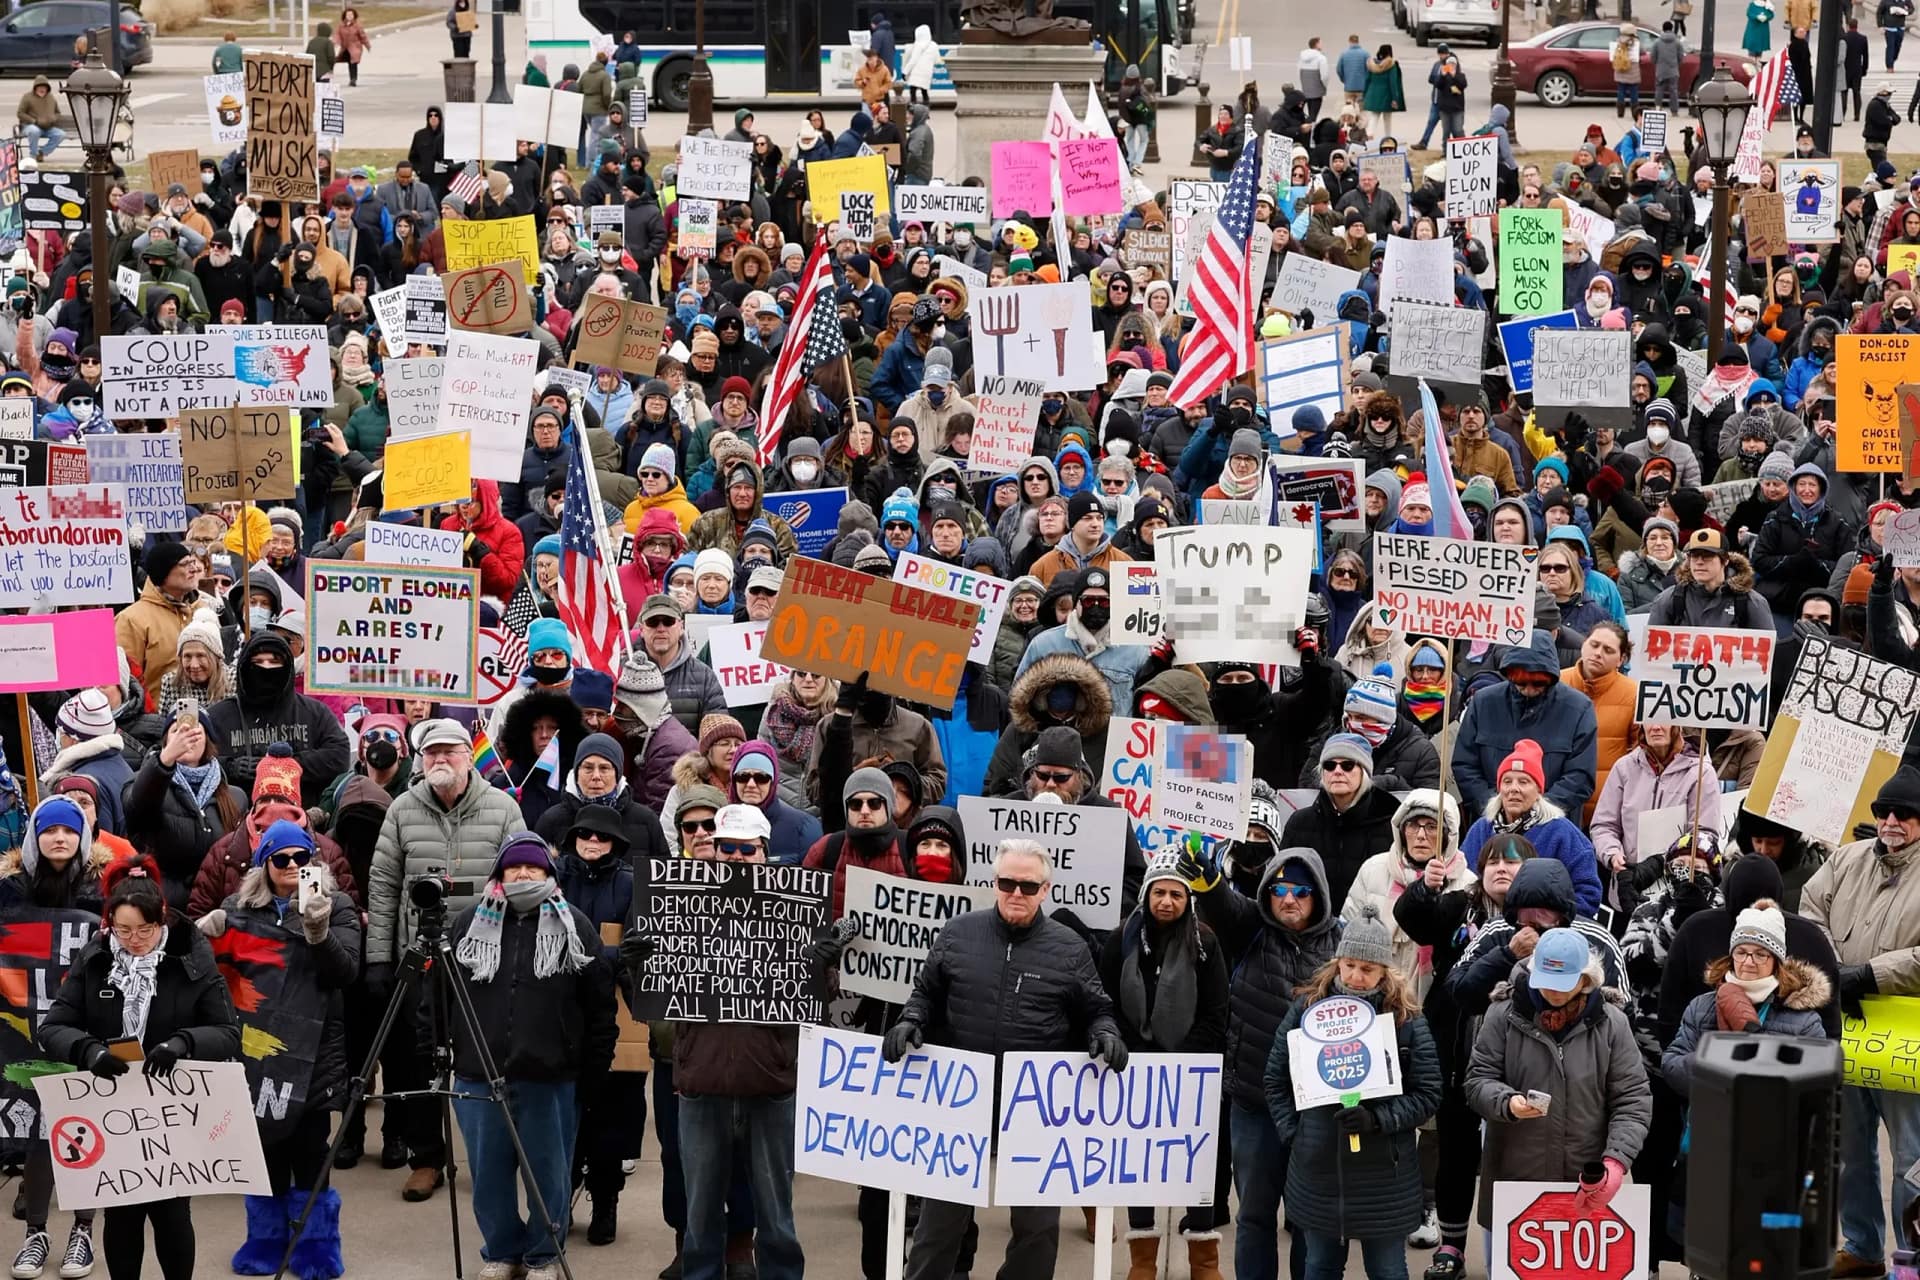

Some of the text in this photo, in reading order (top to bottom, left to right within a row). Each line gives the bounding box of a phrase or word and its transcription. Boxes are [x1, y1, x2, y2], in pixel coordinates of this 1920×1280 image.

[246, 60, 313, 98] DEPORT
[251, 97, 309, 136] ELON
[250, 137, 316, 179] MUSK
[703, 141, 720, 156] THE
[1063, 144, 1085, 158] IF
[1452, 140, 1492, 157] LOCK
[696, 163, 739, 177] REJECT
[1463, 160, 1480, 176] UP
[683, 176, 749, 192] PROJECT 2025
[1450, 177, 1490, 194] ELON
[841, 194, 874, 210] LOCK
[901, 193, 917, 210] DO
[920, 194, 985, 214] SOMETHING
[1448, 199, 1498, 216] FE-LON
[847, 210, 874, 225] HIM
[1513, 215, 1545, 231] FORK
[450, 220, 527, 240] STOP THE
[854, 223, 872, 238] UP!
[1507, 230, 1556, 246] FASCISM
[457, 240, 529, 257] ILLEGAL
[1295, 258, 1327, 279] It's
[1512, 257, 1550, 273] ELON
[122, 271, 132, 284] NO
[1284, 273, 1317, 293] giving
[1514, 275, 1548, 290] MUSK
[1514, 290, 1543, 311] GO
[590, 306, 654, 333] COUP NO
[233, 329, 254, 341] ONE
[258, 328, 272, 341] IS
[275, 327, 326, 341] ILLEGAL
[1407, 327, 1473, 350] REJECT
[1860, 339, 1910, 349] DON-OLD
[127, 339, 209, 364] COUP
[457, 344, 481, 361] Elon
[623, 344, 657, 361] 2025
[1538, 336, 1628, 364] BIG GRETCH
[1859, 352, 1907, 362] FASCIST
[109, 362, 225, 376] IN PROGRESS
[1400, 350, 1451, 372] PROJECT
[1538, 362, 1624, 379] WE NEED YOUR
[126, 379, 205, 393] THIS IS
[250, 388, 328, 402] STOLEN LAND
[390, 384, 439, 399] doesn't
[981, 375, 1006, 396] NO
[114, 397, 170, 413] NOT A
[448, 403, 521, 426] TERRORIST
[979, 398, 1030, 419] Racist
[190, 412, 280, 442] NO TO
[975, 418, 1004, 433] Anti
[141, 439, 174, 458] ICE
[972, 434, 1000, 449] Anti
[1862, 441, 1878, 452] BY
[245, 447, 283, 493] 2025
[974, 450, 1020, 469] Policies
[128, 487, 184, 507] FASCISTS
[1286, 479, 1335, 494] democracy
[15, 490, 40, 523] te
[134, 511, 185, 529] TRUMP
[371, 527, 461, 554] DEMOCRACY
[6, 548, 128, 572] let the bastards
[1156, 529, 1283, 577] Trump
[1443, 543, 1531, 575] QUEER,
[31, 567, 113, 595] you down!
[314, 574, 472, 601] DEPORT ELONIA
[903, 559, 1006, 604] PROTECT
[1389, 561, 1526, 594] PISSED OFF!
[791, 559, 981, 629] THREAT LEVEL:
[368, 597, 412, 615] AND
[1377, 591, 1525, 629] NO HUMAN IS
[336, 620, 444, 642] ARREST!
[1401, 612, 1499, 640] ILLEGAL!!
[773, 604, 965, 697] ORANGE
[1645, 629, 1771, 673] DEATH
[1672, 663, 1717, 687] TO
[1800, 636, 1920, 708] REJECT
[1636, 680, 1769, 731] FASCISM
[1784, 667, 1919, 743] FASCISM
[281, 723, 308, 742] STATE
[1166, 781, 1234, 804] STOP FACISM
[1195, 801, 1204, 811] &
[989, 807, 1081, 836] TARIFFS
[1163, 807, 1235, 831] PROJECT 2025
[650, 859, 832, 897] DEFEND PROTECT
[875, 883, 972, 921] DEFEND
[1052, 883, 1111, 907] CLASS
[643, 954, 747, 976] REPRODUCTIVE
[641, 973, 705, 994] CLIMATE
[665, 995, 707, 1018] ALL
[719, 997, 823, 1021] HUMANS!!!
[1315, 1004, 1358, 1022] STOP
[1316, 1016, 1359, 1030] PROJECT
[1326, 1025, 1353, 1037] 2025
[1323, 1041, 1362, 1058] STOP
[1324, 1054, 1363, 1068] PROJECT
[819, 1036, 979, 1109] DEFEND
[1327, 1064, 1365, 1082] 2025
[63, 1069, 213, 1101] DO NOT
[1001, 1060, 1221, 1132] ACCOUNT
[102, 1103, 200, 1136] OBEY
[140, 1135, 171, 1161] IN
[804, 1106, 989, 1189] DEMOCRACY
[1011, 1132, 1210, 1194] -ABILITY
[94, 1159, 249, 1197] ADVANCE
[1516, 1216, 1626, 1274] STOP
